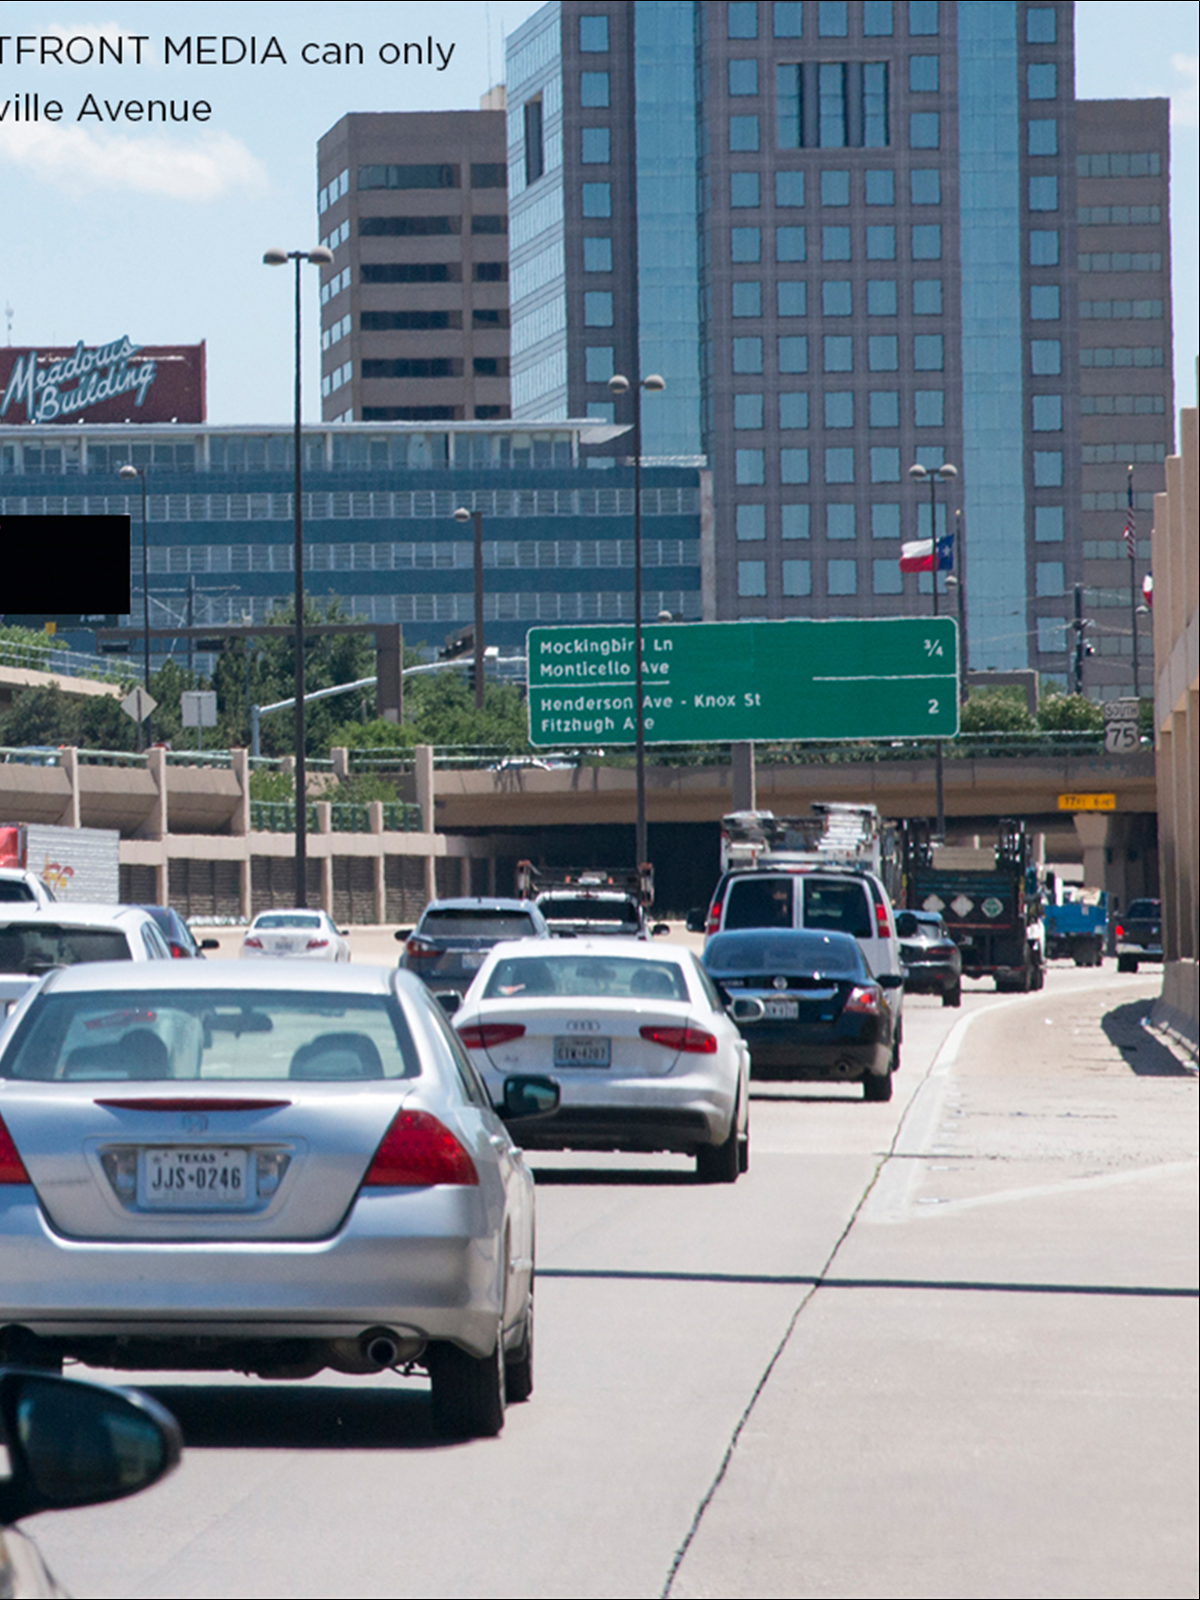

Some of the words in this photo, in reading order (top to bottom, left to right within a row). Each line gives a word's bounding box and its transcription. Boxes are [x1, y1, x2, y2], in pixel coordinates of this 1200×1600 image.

[35, 360, 157, 423] Building
[653, 639, 673, 651] Ln
[540, 660, 631, 677] Monticello
[641, 660, 670, 674] Ave
[541, 695, 634, 711] Henderson
[642, 694, 673, 709] Ave
[694, 694, 736, 708] Knox
[744, 692, 761, 707] St
[928, 698, 940, 714] 2
[541, 716, 615, 733] Fitzhugh
[623, 716, 655, 730] Ae
[1109, 727, 1136, 748] 75
[176, 1153, 217, 1164] TEXAS
